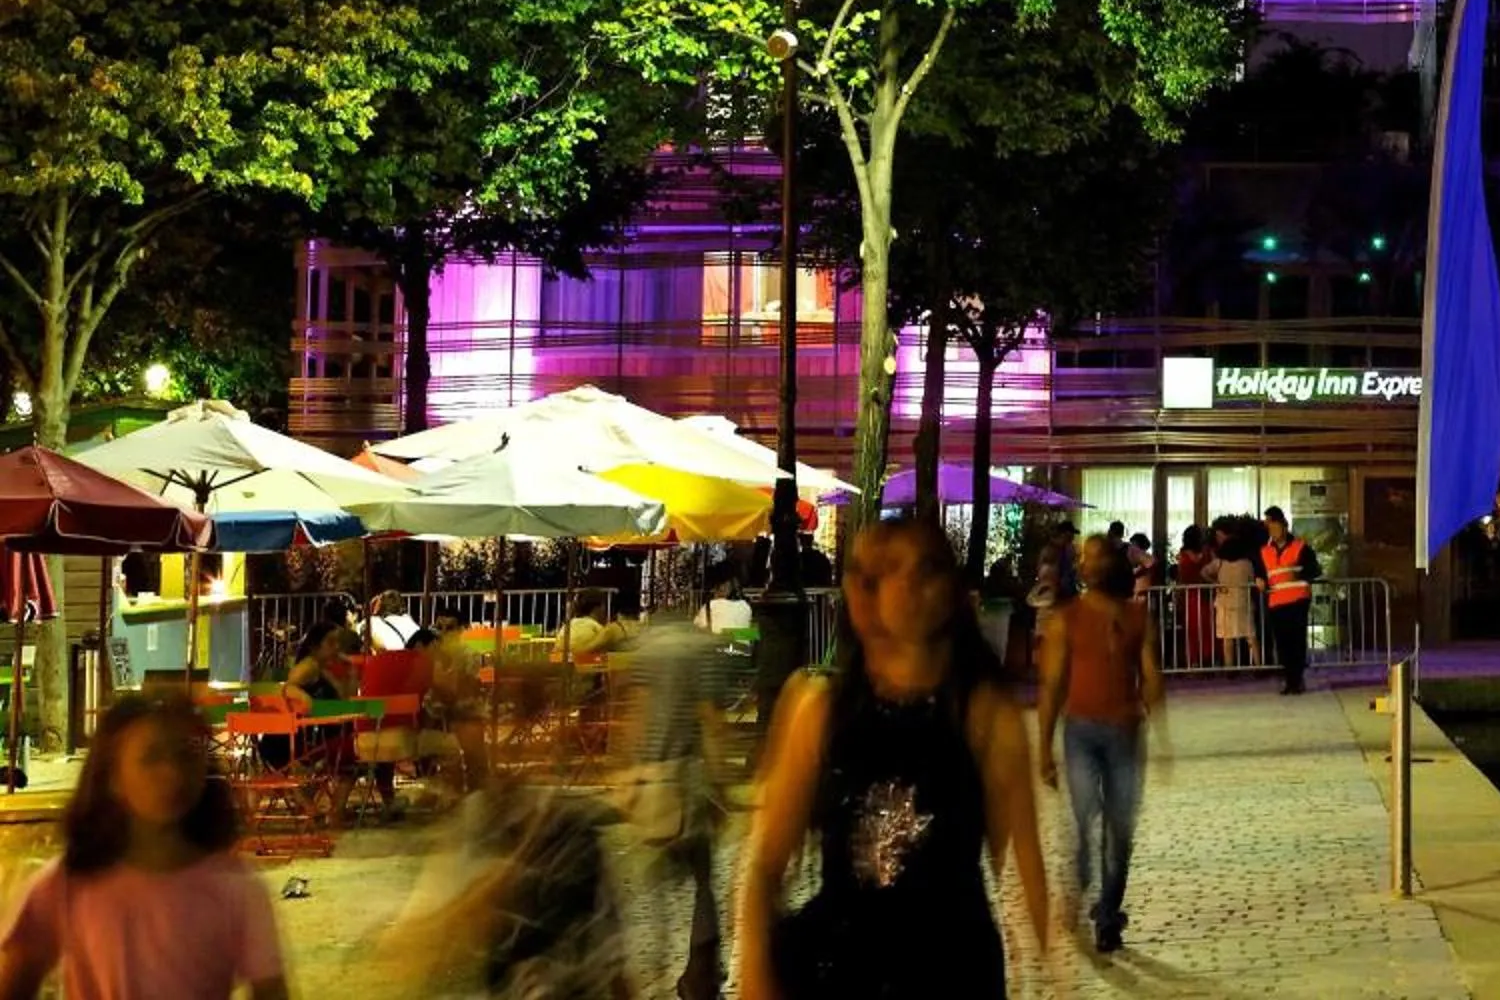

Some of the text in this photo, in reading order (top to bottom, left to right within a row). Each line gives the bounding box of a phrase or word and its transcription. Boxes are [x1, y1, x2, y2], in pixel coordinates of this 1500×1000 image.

[1217, 367, 1423, 403] Holiday Inn Expre
